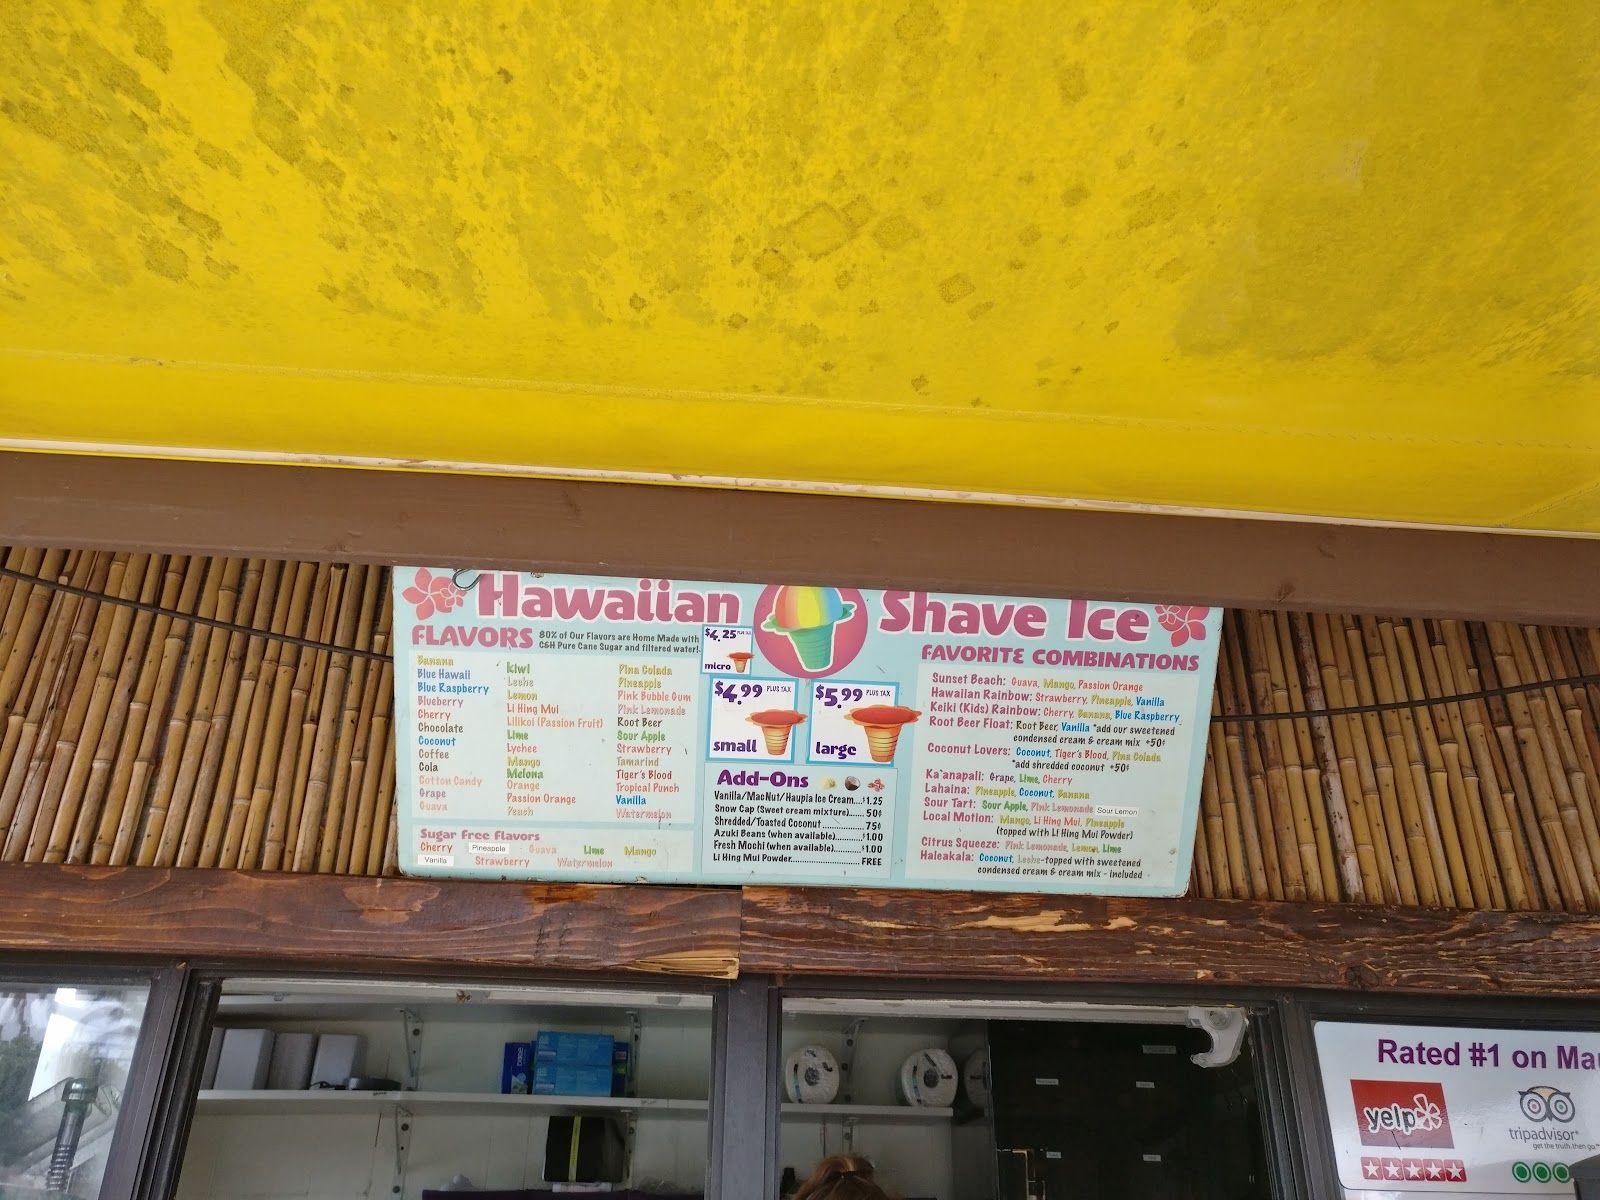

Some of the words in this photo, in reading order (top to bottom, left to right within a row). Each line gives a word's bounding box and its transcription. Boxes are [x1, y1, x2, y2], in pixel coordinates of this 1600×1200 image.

[478, 573, 740, 624] Hawaiian
[879, 590, 1047, 638] Shave
[1067, 599, 1150, 642] Ice
[411, 625, 534, 649] FLAVORS
[539, 631, 557, 639] 80%
[559, 631, 568, 640] of
[569, 631, 585, 640] Our
[587, 631, 616, 641] Flavors
[617, 634, 631, 642] are
[632, 633, 655, 642] Home
[657, 634, 680, 643] Made
[681, 635, 700, 643] with
[539, 641, 556, 649] C&H
[558, 641, 576, 650] Pure
[578, 642, 598, 651] Cane
[600, 643, 623, 652] Sugar
[625, 643, 640, 651] and
[642, 643, 672, 652] filtered
[921, 644, 1025, 664] FAVORITE
[1032, 650, 1199, 672] COMBINATIONS
[704, 661, 731, 670] micro
[417, 668, 436, 679] Blue
[438, 669, 471, 680] Hawaii
[932, 672, 968, 684] Sunset
[970, 673, 1006, 686] Beach:
[1078, 679, 1110, 690] Passion
[1112, 680, 1143, 692] Orange
[417, 682, 436, 692] Blue
[439, 683, 489, 696] Raspberry
[714, 680, 763, 705] $4.99
[417, 695, 464, 707] Blueberry
[815, 684, 863, 709] $5.99
[931, 687, 980, 699] Hawaiian
[983, 689, 1033, 702] Rainbow:
[1136, 696, 1165, 707] Vanilla
[417, 709, 451, 721] Cherry
[507, 703, 515, 713] Li
[517, 703, 538, 715] Hing
[540, 704, 559, 714] Mui
[930, 701, 956, 713] Keiki
[959, 702, 989, 715] (Kids)
[991, 703, 1041, 717] Rainbow:
[1115, 709, 1132, 720] Blue
[418, 722, 464, 733] Chocolate
[617, 717, 640, 727] Root
[641, 717, 663, 728] Beer
[929, 715, 954, 727] Root
[957, 716, 980, 728] Beer
[983, 718, 1013, 730] Float:
[1015, 720, 1037, 730] Root
[1061, 722, 1090, 733] Vanilla
[1113, 725, 1127, 734] our
[1129, 726, 1175, 736] sweetened
[418, 735, 457, 746] Coconut
[507, 730, 529, 740] Lime
[617, 730, 639, 741] Sour
[640, 731, 666, 743] Apple
[1013, 733, 1058, 744] condensed
[1059, 736, 1086, 745] cream
[1096, 737, 1123, 747] cream
[1125, 738, 1141, 747] mix
[507, 743, 538, 754] Lychee
[616, 743, 672, 755] Strawberry
[713, 739, 757, 753] small
[815, 741, 857, 760] large
[927, 742, 971, 755] Coconut
[974, 743, 1011, 756] Lovers:
[418, 748, 449, 759] Coffee
[418, 761, 439, 772] Cola
[1032, 760, 1069, 770] shredded
[1071, 762, 1106, 772] coconut
[616, 769, 646, 781] Tiger's
[649, 770, 672, 780] Blood
[716, 769, 809, 788] Add-Ons
[1042, 774, 1073, 786] Cherry
[507, 780, 540, 791] Orange
[616, 782, 651, 794] Tropical
[653, 783, 680, 793] Punch
[924, 783, 970, 795] Lahaina:
[419, 787, 446, 799] Grape
[507, 792, 541, 803] Passion
[543, 793, 576, 805] Orange
[815, 793, 826, 803] Ice
[615, 794, 647, 805] Vanilla
[923, 796, 949, 808] Sour
[951, 798, 976, 809] Tart:
[981, 800, 1002, 810] Sour
[1096, 806, 1113, 814] Sour
[714, 804, 737, 813] Snow
[739, 804, 755, 815] Cap
[756, 805, 783, 815] (Sweet
[788, 819, 822, 829] Coconut
[923, 810, 951, 821] Local
[953, 812, 994, 824] Motion:
[1033, 816, 1041, 825] Li
[1043, 816, 1062, 827] Hing
[420, 828, 457, 843] Sugar
[714, 829, 739, 838] Azuki
[740, 829, 766, 838] Beans
[768, 830, 791, 840] (when
[996, 826, 1027, 837] (topped
[1029, 827, 1050, 837] with
[1052, 828, 1060, 837] Li
[1061, 829, 1079, 839] Hing
[1081, 829, 1099, 839] Mui
[1100, 830, 1133, 840] Powder)
[420, 842, 453, 853] Cherry
[583, 845, 605, 855] Lime
[713, 840, 736, 850] Fresh
[738, 841, 765, 851] Mochi
[766, 842, 788, 852] (when
[921, 836, 953, 847] Citrus
[955, 838, 1000, 849] Squeeze:
[1102, 843, 1122, 854] Lime
[424, 856, 447, 864] Vanilla
[475, 856, 530, 868] Strawberry
[713, 853, 721, 861] Li
[722, 853, 741, 863] Hing
[743, 854, 760, 862] Mui
[861, 857, 882, 866] FREE
[920, 850, 975, 862] Haleakala:
[1074, 856, 1095, 866] with
[1096, 858, 1142, 867] sweetened
[977, 866, 1020, 875] condensed
[1022, 867, 1048, 876] cream
[1058, 868, 1084, 877] cream
[1086, 869, 1101, 878] mix
[1109, 869, 1143, 879] included
[1377, 1038, 1460, 1066] Rated
[1468, 1042, 1500, 1067] #1
[1512, 1049, 1547, 1069] on
[1556, 1045, 1600, 1070] Ma
[1365, 1102, 1417, 1135] yelp
[1532, 1142, 1544, 1150] get
